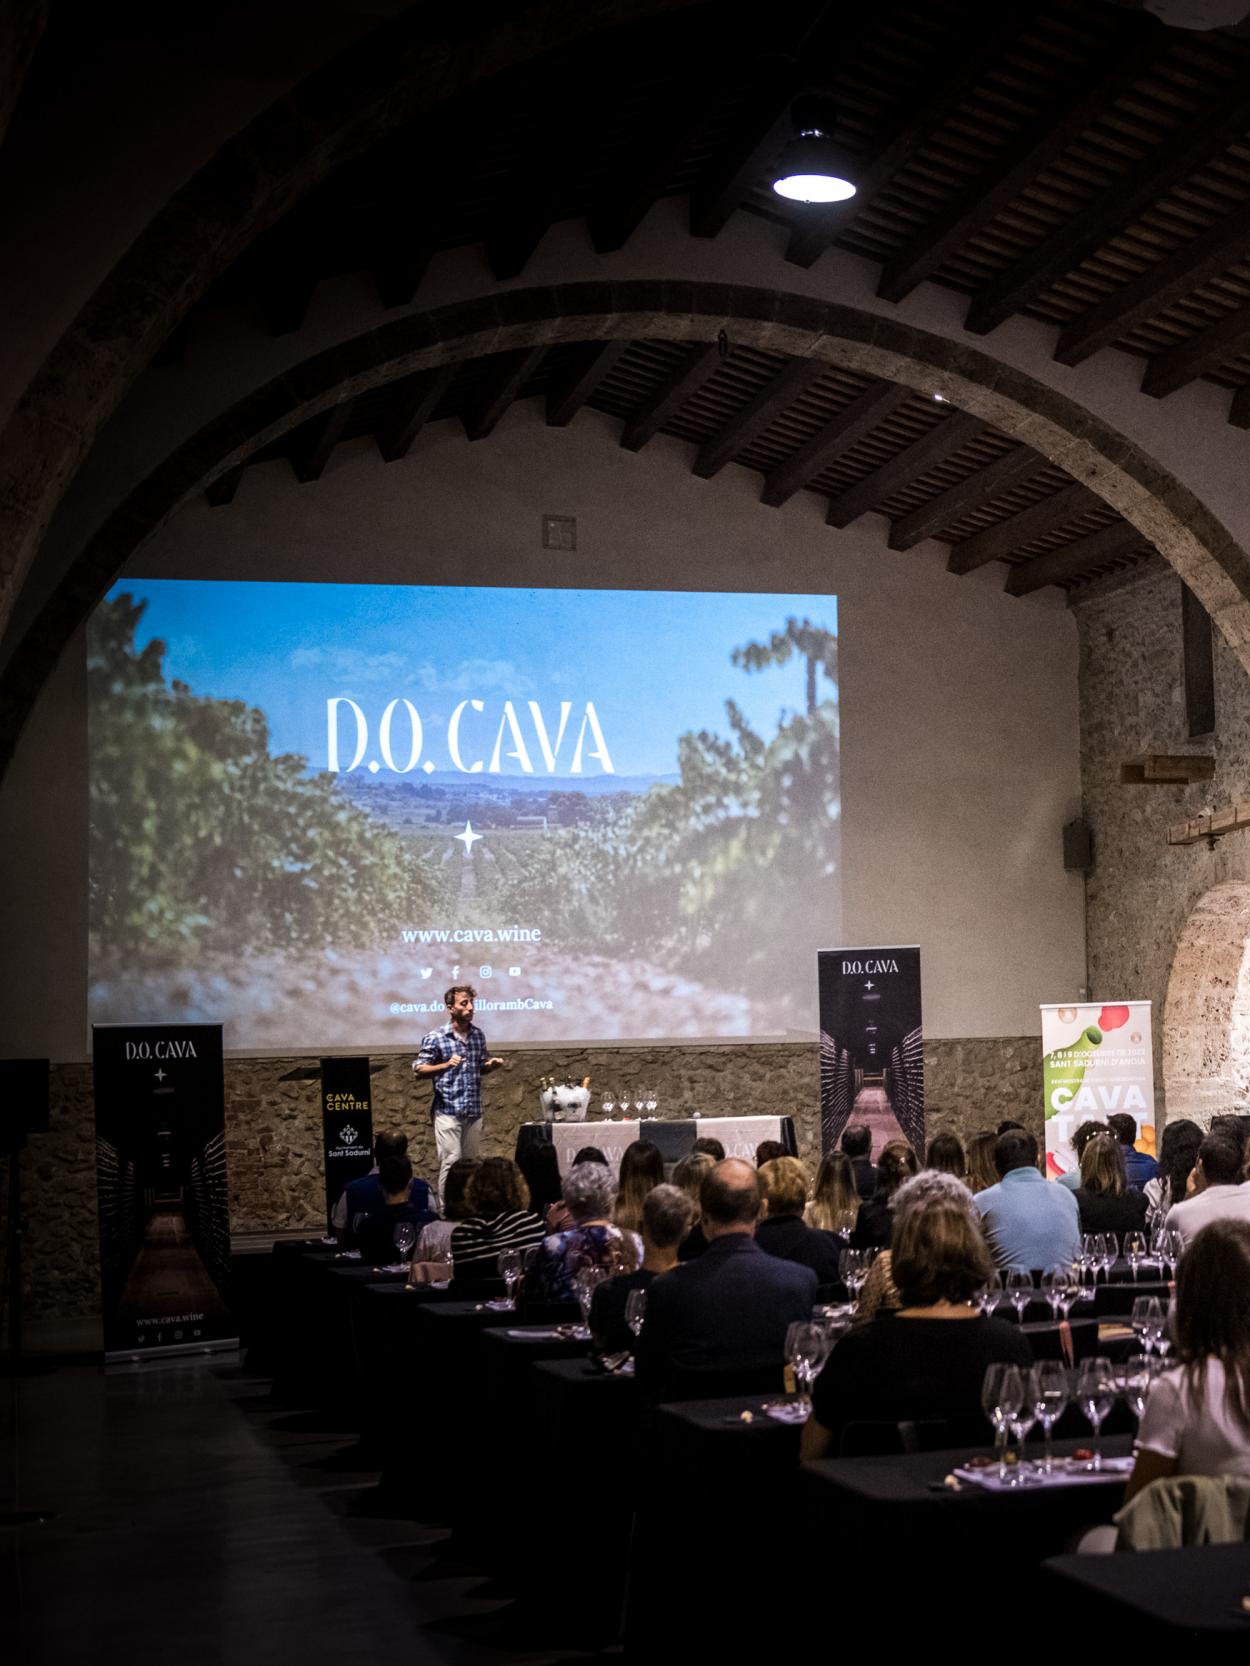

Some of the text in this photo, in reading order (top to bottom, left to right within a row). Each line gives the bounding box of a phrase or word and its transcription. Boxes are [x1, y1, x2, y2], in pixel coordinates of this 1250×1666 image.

[326, 697, 616, 774] D.O. CAVA
[401, 924, 542, 943] www.cava.wine
[841, 959, 899, 975] D.O. CAVA
[389, 998, 553, 1014] @cava.do illorambCava
[125, 1040, 198, 1060] D.O. CAVA
[1049, 1059, 1071, 1068] SANT
[326, 1093, 355, 1102] CAVA
[1050, 1084, 1147, 1111] CAVA
[326, 1101, 369, 1111] CENTRE
[136, 1312, 205, 1327] www.cava.wine
